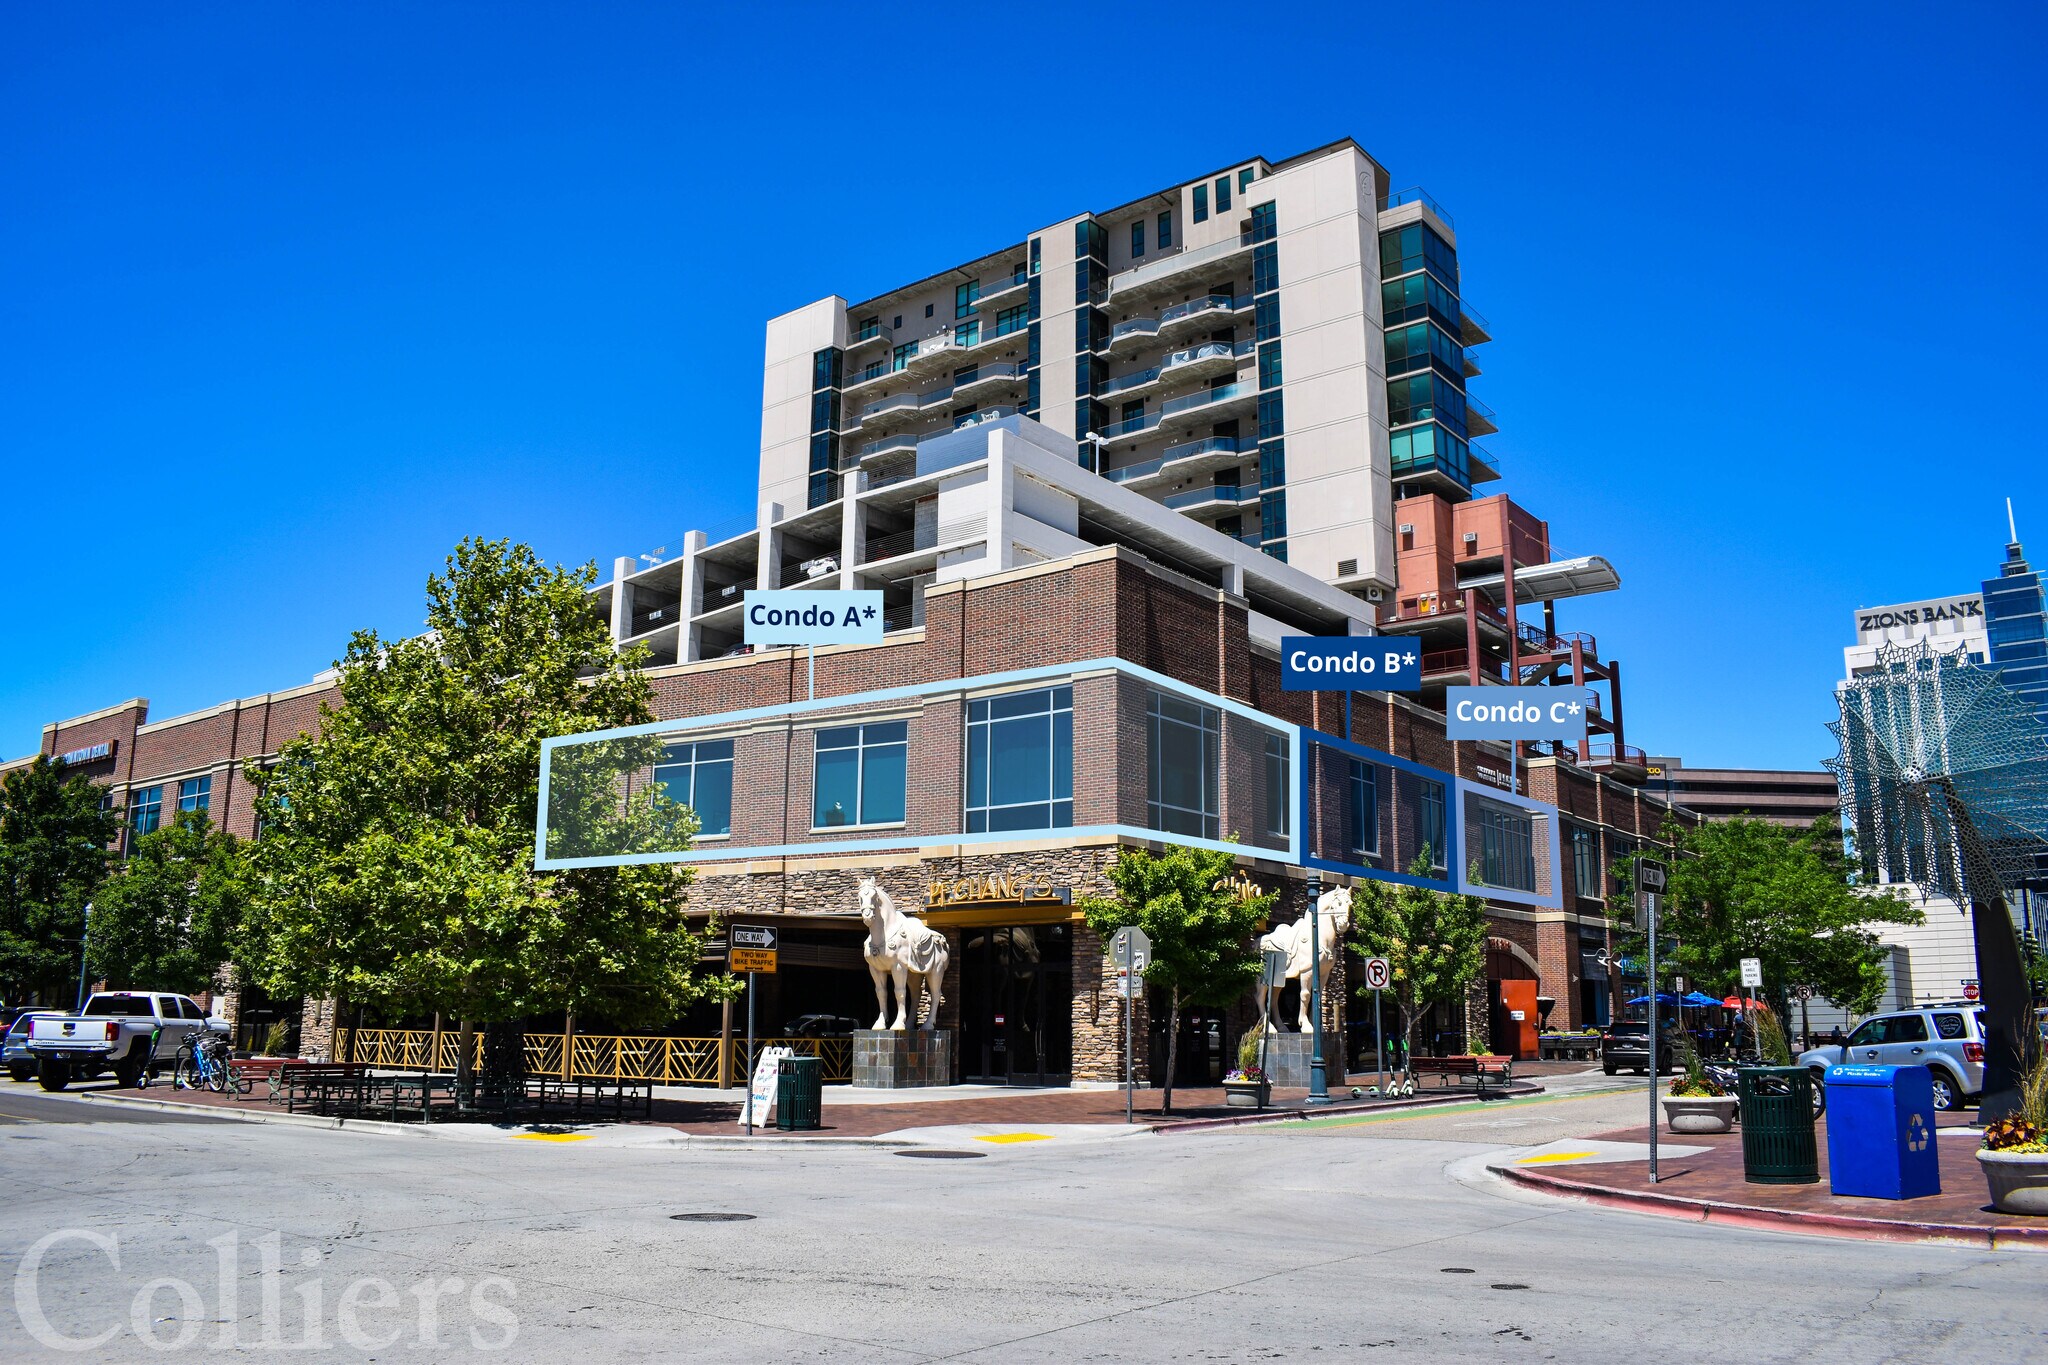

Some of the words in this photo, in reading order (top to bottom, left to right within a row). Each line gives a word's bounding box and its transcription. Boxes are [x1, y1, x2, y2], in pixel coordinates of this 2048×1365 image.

[1860, 609, 1919, 631] ZIONS
[1922, 600, 1983, 623] BANK
[1644, 868, 1652, 883] ONE
[736, 932, 749, 941] ONE
[751, 933, 764, 942] WAY
